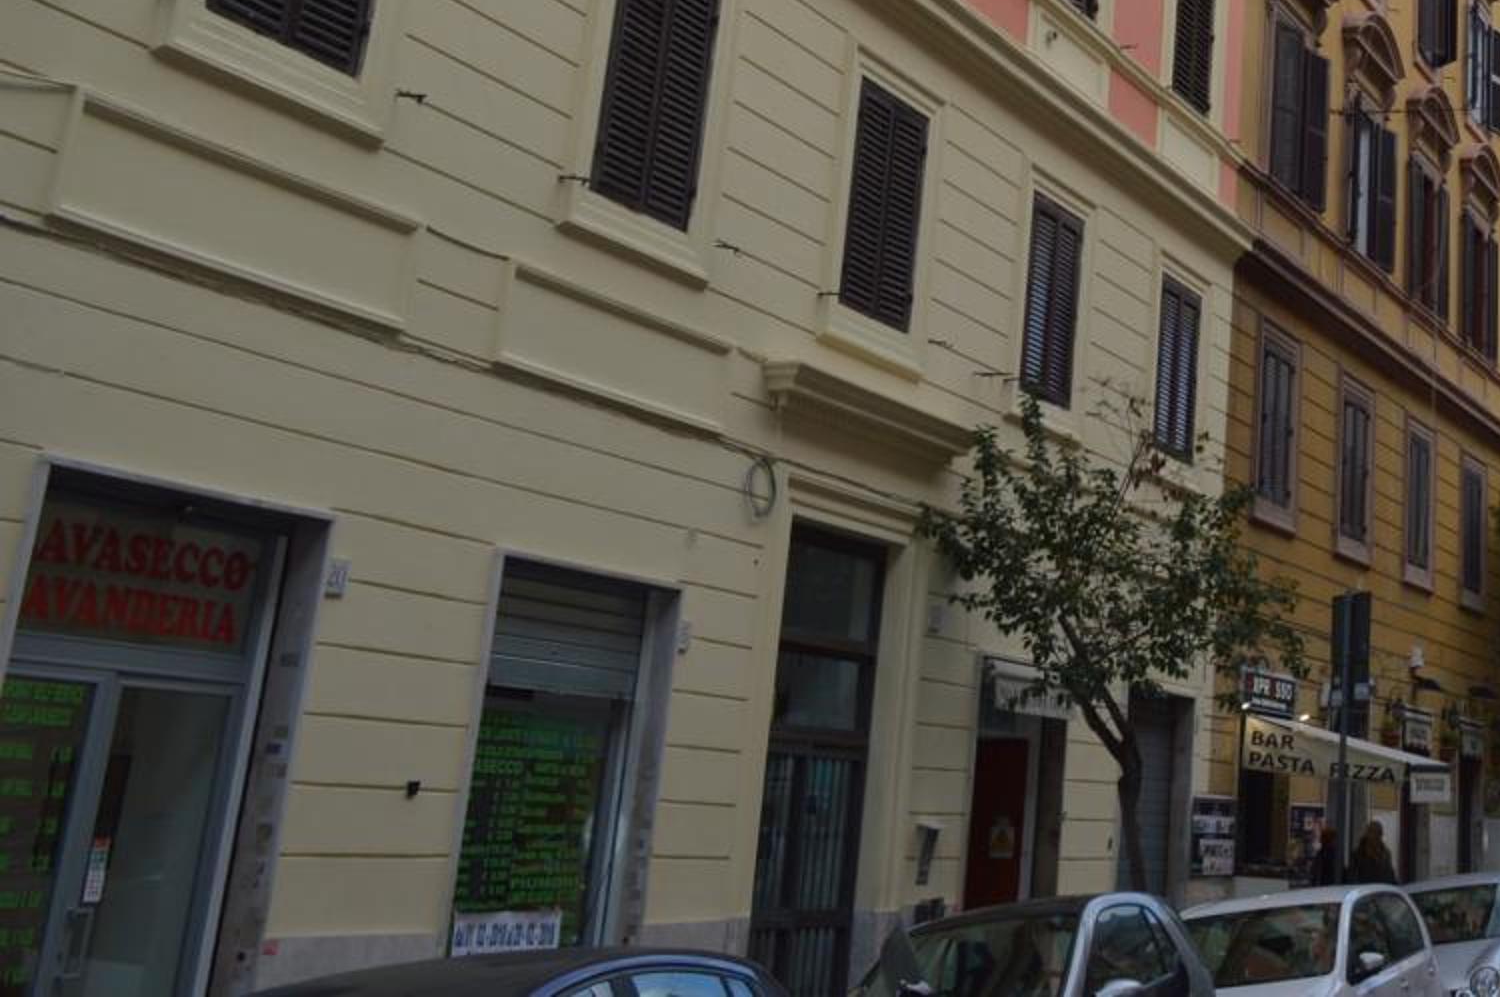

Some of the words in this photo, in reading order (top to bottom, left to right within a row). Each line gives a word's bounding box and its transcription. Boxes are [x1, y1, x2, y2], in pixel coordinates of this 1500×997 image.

[33, 518, 250, 590] AVASECCO
[22, 572, 236, 645] AVANDERIA
[1251, 730, 1294, 750] BAR
[1249, 751, 1315, 776] PASTA
[1329, 761, 1396, 782] PIZZA
